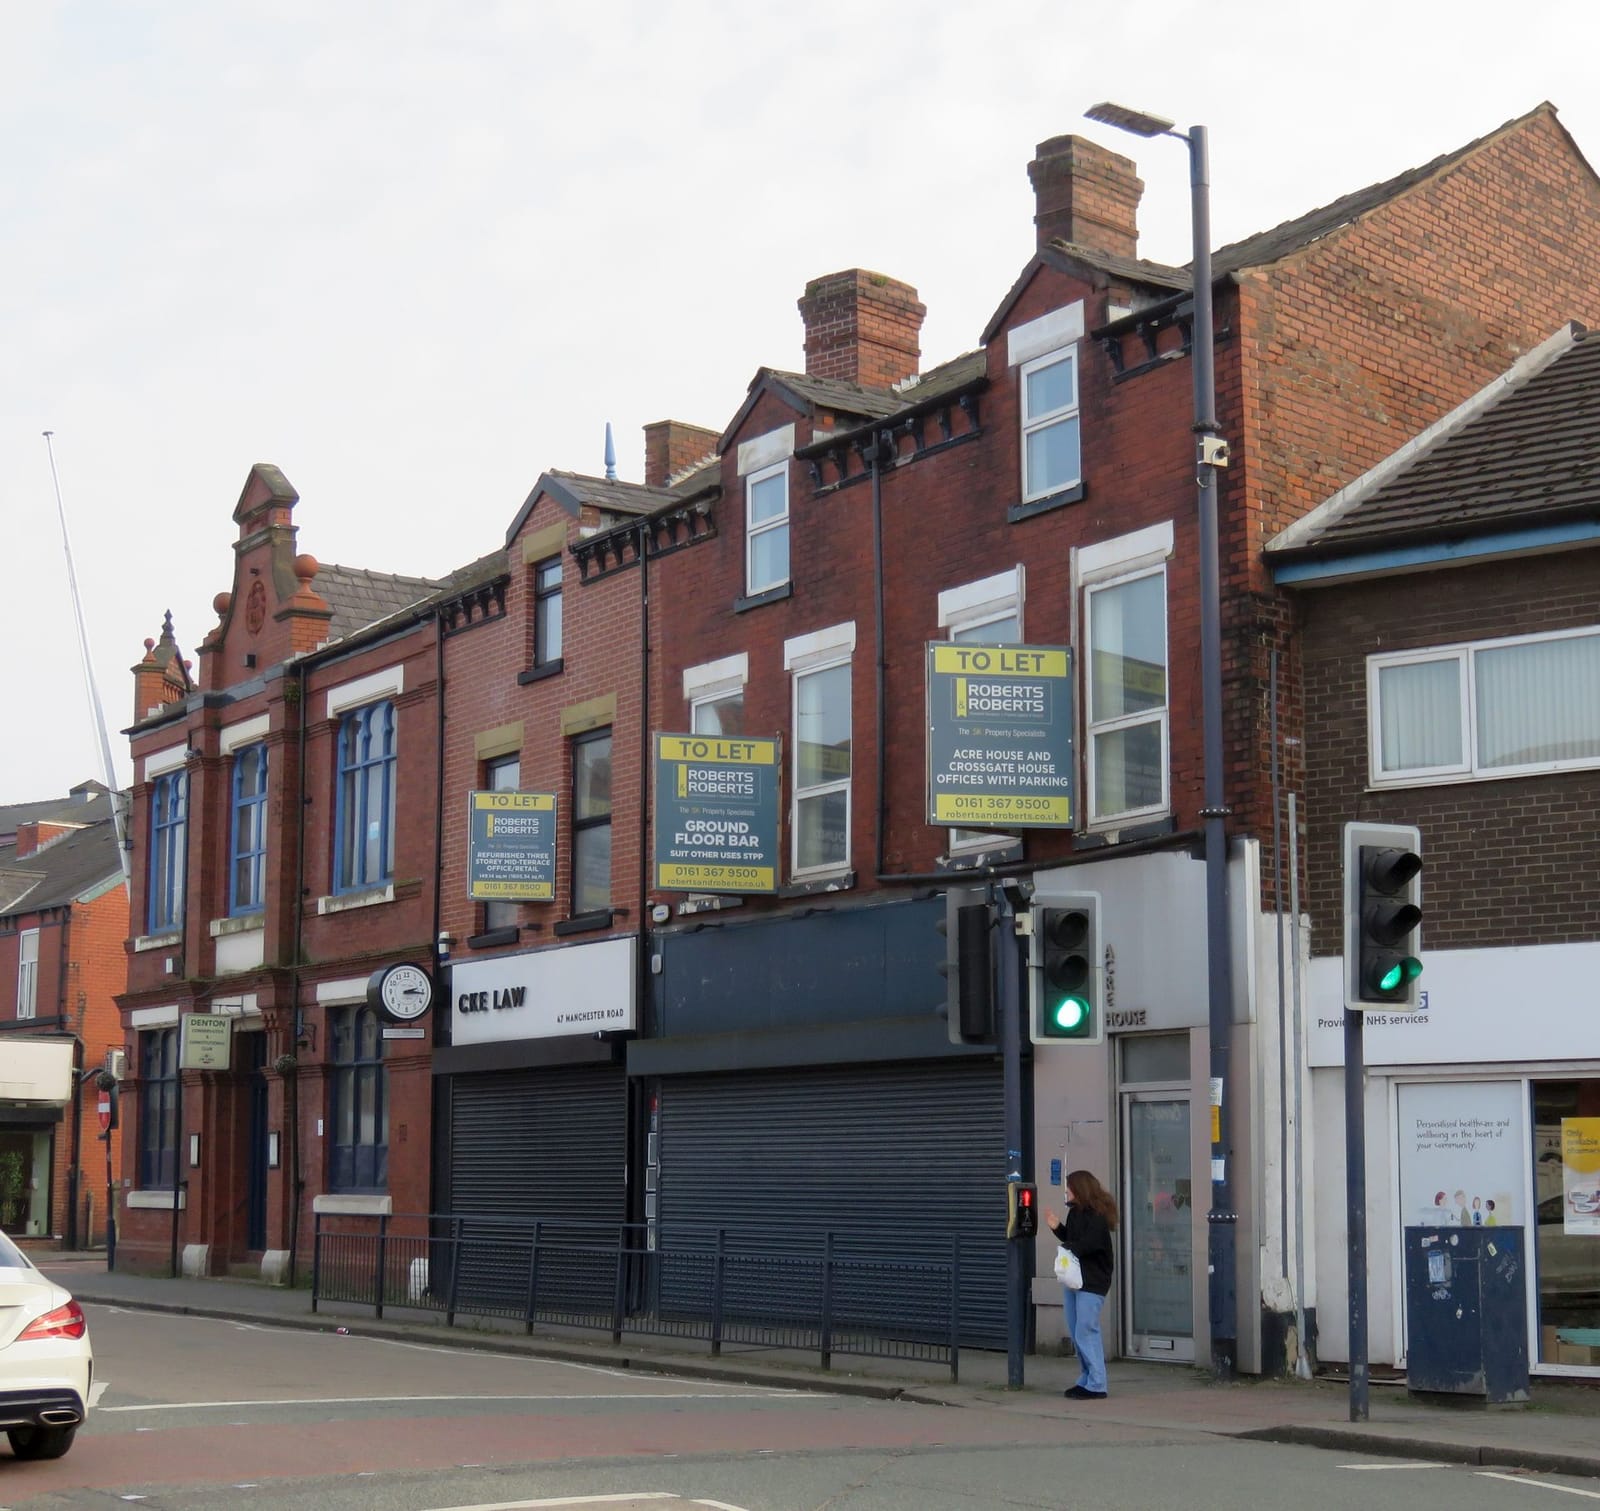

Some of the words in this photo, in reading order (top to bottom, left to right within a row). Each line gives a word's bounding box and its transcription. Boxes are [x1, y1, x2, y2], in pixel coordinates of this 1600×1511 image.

[957, 652, 990, 670] TO
[1001, 653, 1045, 672] LET
[969, 685, 1043, 698] ROBERTS
[969, 698, 1044, 712] ROBERTS
[985, 729, 1011, 737] Property
[1013, 729, 1046, 737] Specialists
[679, 742, 708, 757] TO
[717, 743, 755, 760] LET
[953, 750, 982, 759] ACRE
[987, 751, 1023, 760] HOUSE
[1028, 752, 1051, 761] AND
[949, 762, 1014, 772] CROSSGATE
[1018, 764, 1055, 773] HOUSE
[689, 770, 753, 782] ROBERTS
[937, 775, 983, 784] OFFICES
[987, 776, 1015, 785] WITH
[1019, 776, 1068, 786] PARKING
[689, 782, 754, 794] ROBERTS
[490, 796, 508, 806] TO
[514, 797, 539, 806] LET
[955, 798, 982, 808] 0161
[987, 799, 1011, 809] 367
[1016, 799, 1050, 809] 9500
[703, 808, 725, 816] Property
[946, 812, 1059, 820] robertsandroberts.co.uk
[495, 817, 539, 826] ROBERTS
[686, 821, 749, 832] GROUND
[494, 826, 539, 834] ROBERTS
[675, 834, 724, 845] FLOOR
[729, 835, 759, 847] BAR
[676, 867, 699, 876] 0161
[704, 868, 723, 877] 367
[728, 869, 758, 878] 9500
[667, 879, 766, 887] robertsandroberts.co.uk
[1105, 944, 1115, 1006] ACRE
[459, 991, 488, 1013] CKE
[493, 986, 526, 1009] LAW
[557, 1015, 563, 1023] 47
[566, 1010, 604, 1022] MANCHESTER
[607, 1009, 623, 1017] ROAD
[1106, 1010, 1146, 1026] HOUSE
[1367, 1015, 1387, 1025] NHS
[1390, 1013, 1428, 1024] services
[191, 1019, 226, 1027] DENTON
[1416, 1120, 1457, 1128] Personalised
[1459, 1119, 1494, 1127] healthcare
[1497, 1118, 1509, 1127] and
[1416, 1130, 1449, 1141] wellbeing
[1461, 1129, 1472, 1138] the
[1475, 1129, 1493, 1138] heart
[1496, 1128, 1503, 1138] of
[1416, 1142, 1432, 1151] your
